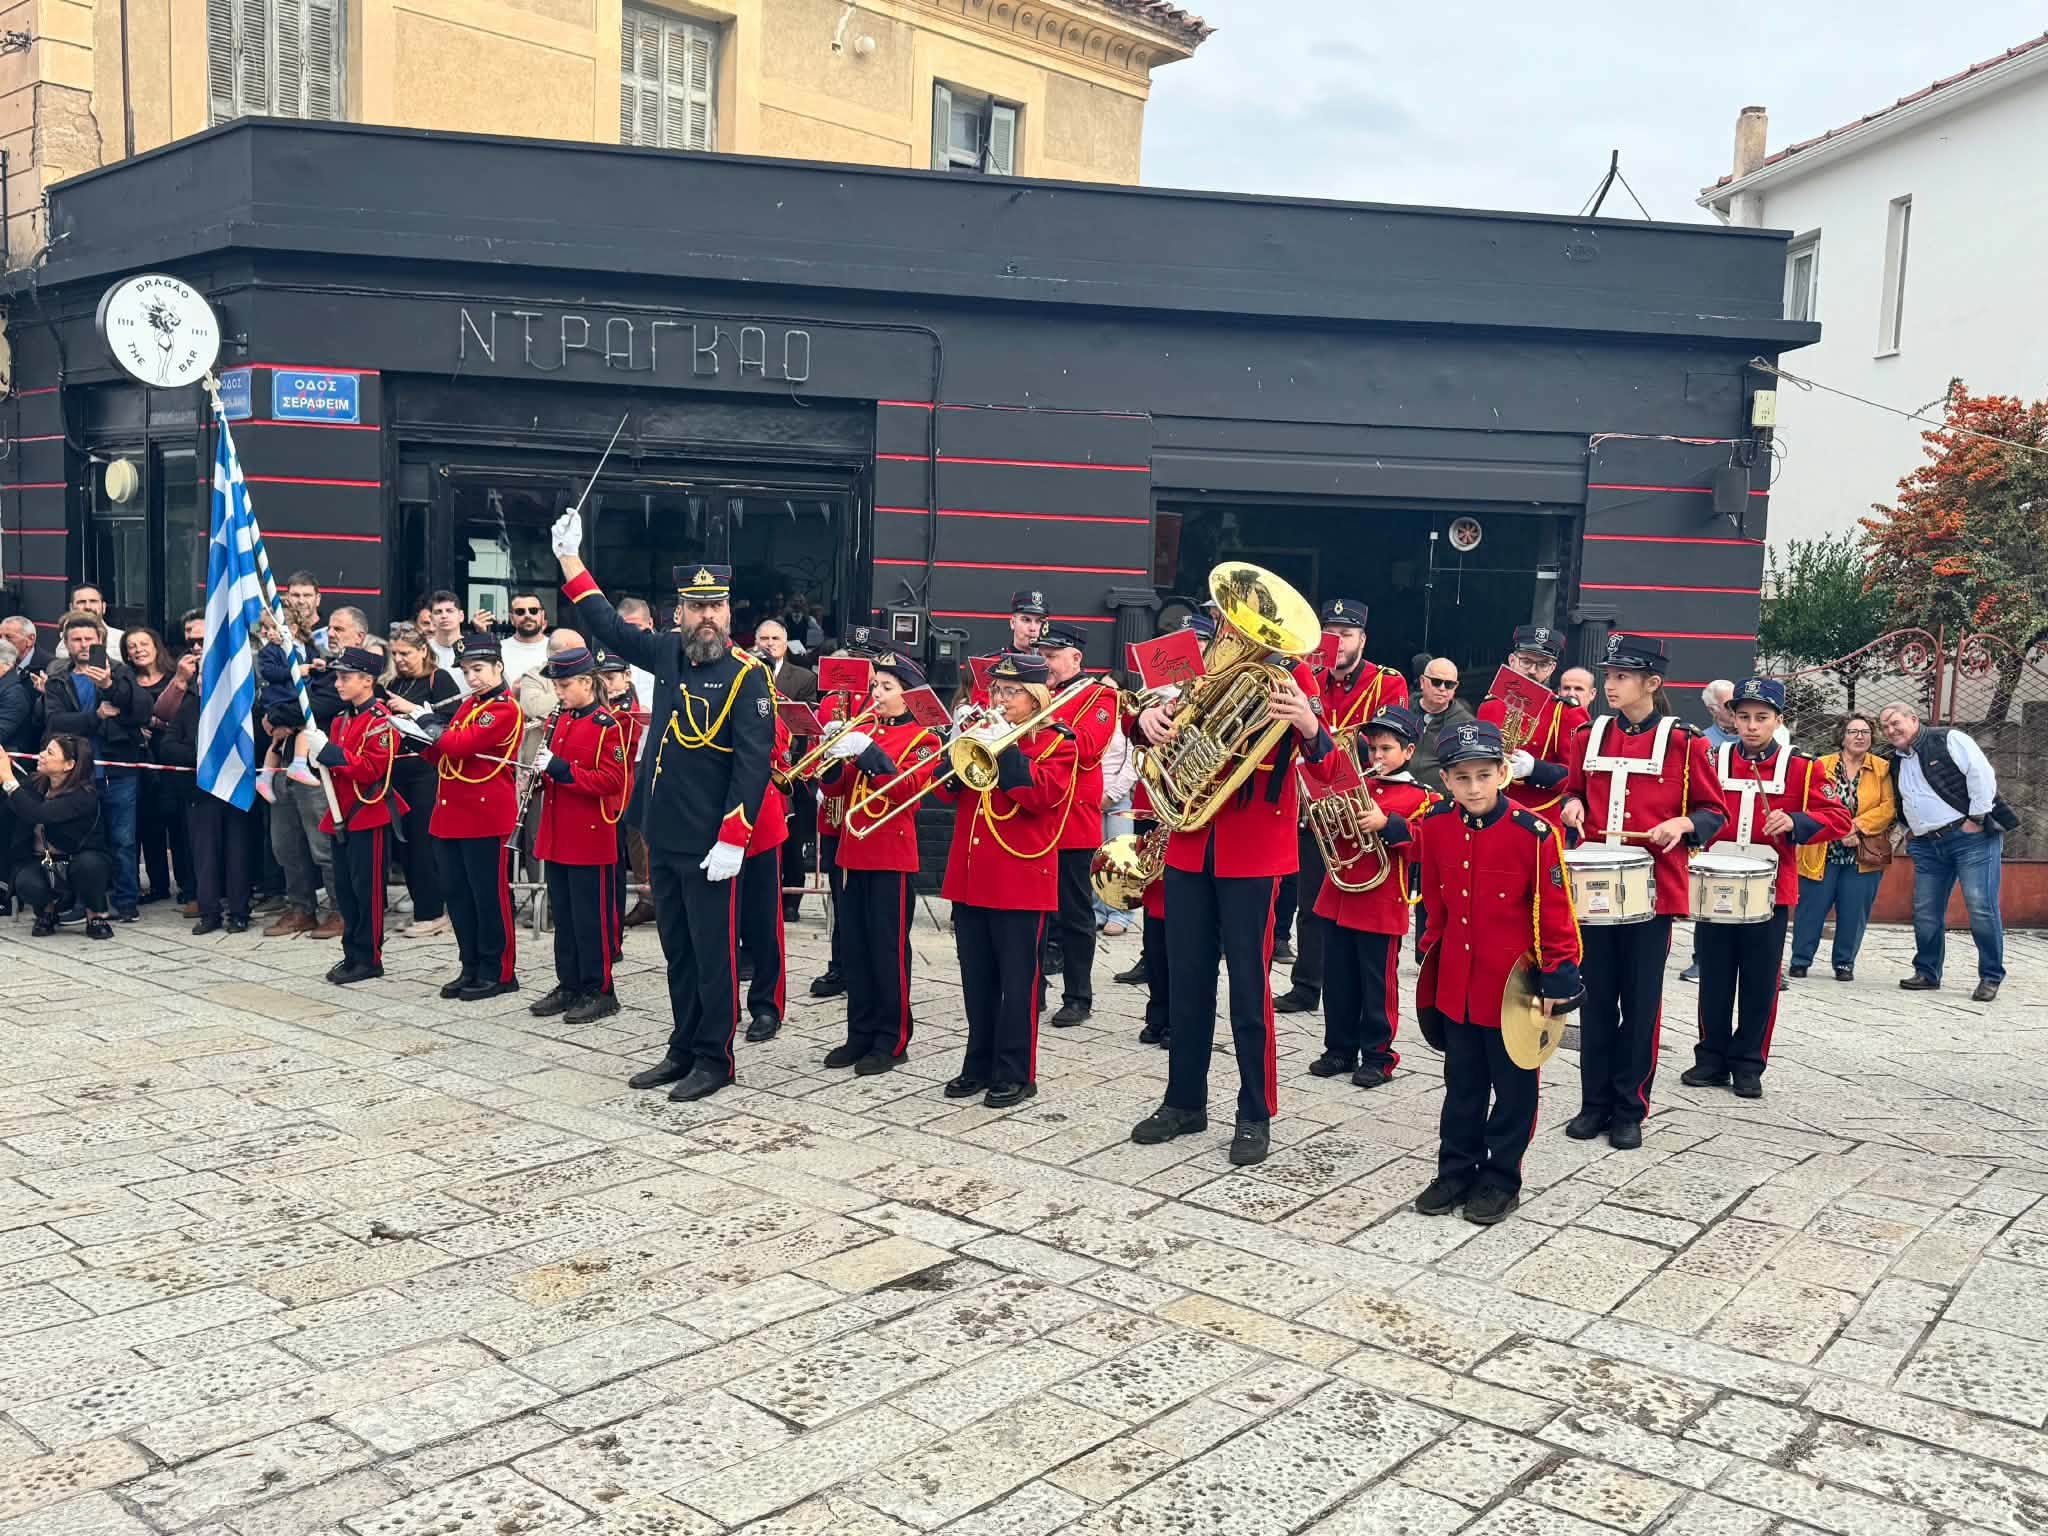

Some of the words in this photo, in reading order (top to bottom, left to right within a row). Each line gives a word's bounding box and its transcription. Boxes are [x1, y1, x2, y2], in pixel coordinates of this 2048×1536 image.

[128, 340, 146, 366] THE
[178, 349, 198, 373] BAR
[294, 379, 337, 392] ΟΔΟΣ
[282, 396, 350, 411] ΣΕΡΑΦΕΙΜ
